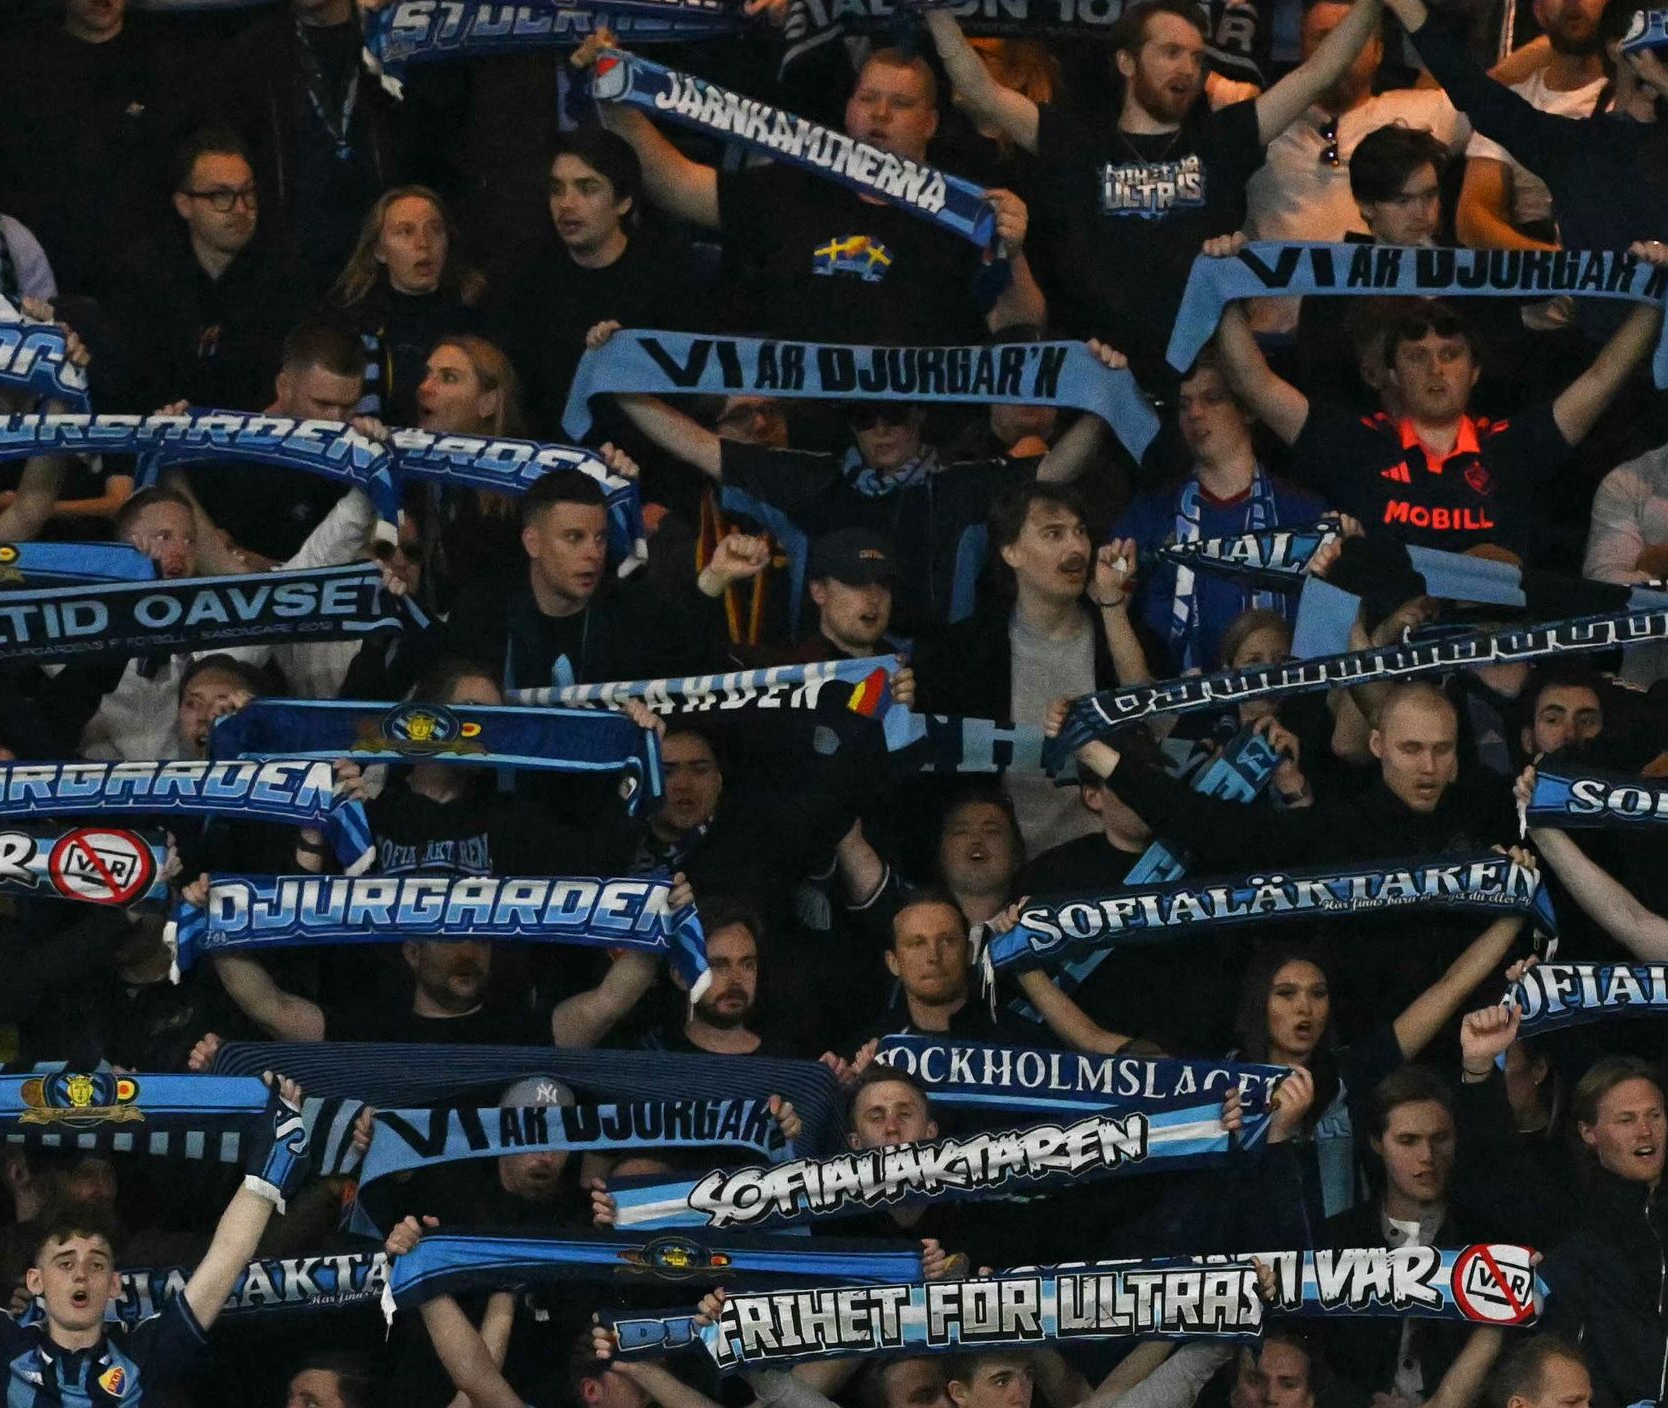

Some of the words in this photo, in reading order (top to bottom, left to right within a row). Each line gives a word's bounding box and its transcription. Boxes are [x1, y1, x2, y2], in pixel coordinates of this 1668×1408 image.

[655, 70, 949, 217] JÄRNKAMINERNA
[637, 337, 743, 388] VI
[1384, 500, 1494, 530] MOBILL
[211, 876, 678, 944] DJURGÅRDEN
[1021, 857, 1542, 953] SOFIALÄKTAREN
[687, 1111, 1150, 1229] SOFIALÄKTAREN
[714, 1283, 912, 1368] FRIHET
[924, 1274, 1043, 1343] FÖR
[1056, 1263, 1265, 1339] ULTRAS
